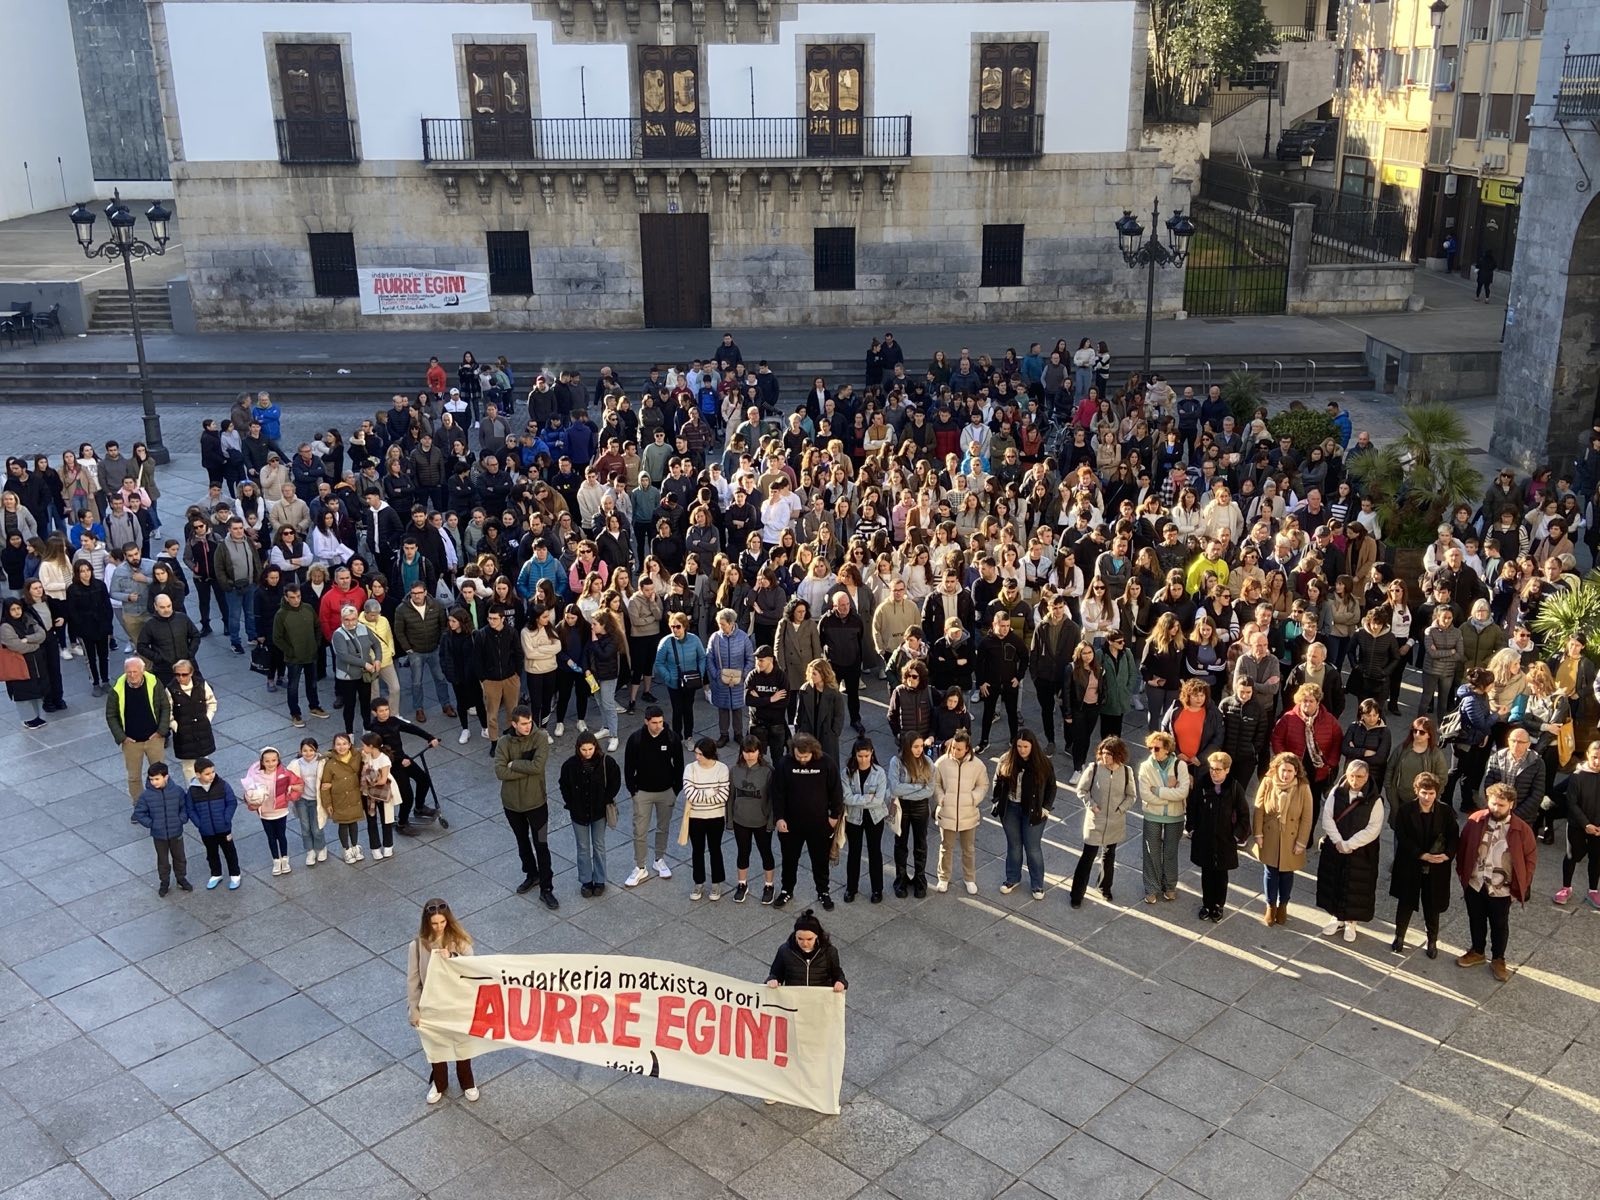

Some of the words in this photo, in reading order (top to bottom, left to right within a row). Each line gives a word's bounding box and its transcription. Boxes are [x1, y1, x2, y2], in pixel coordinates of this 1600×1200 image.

[373, 278, 422, 295] AURRE
[424, 276, 467, 295] EGIN!
[501, 965, 611, 992] indarkeria
[619, 971, 708, 997] matxista
[715, 986, 760, 1009] orori
[468, 983, 641, 1049] AURRE
[655, 995, 788, 1067] EGIN!
